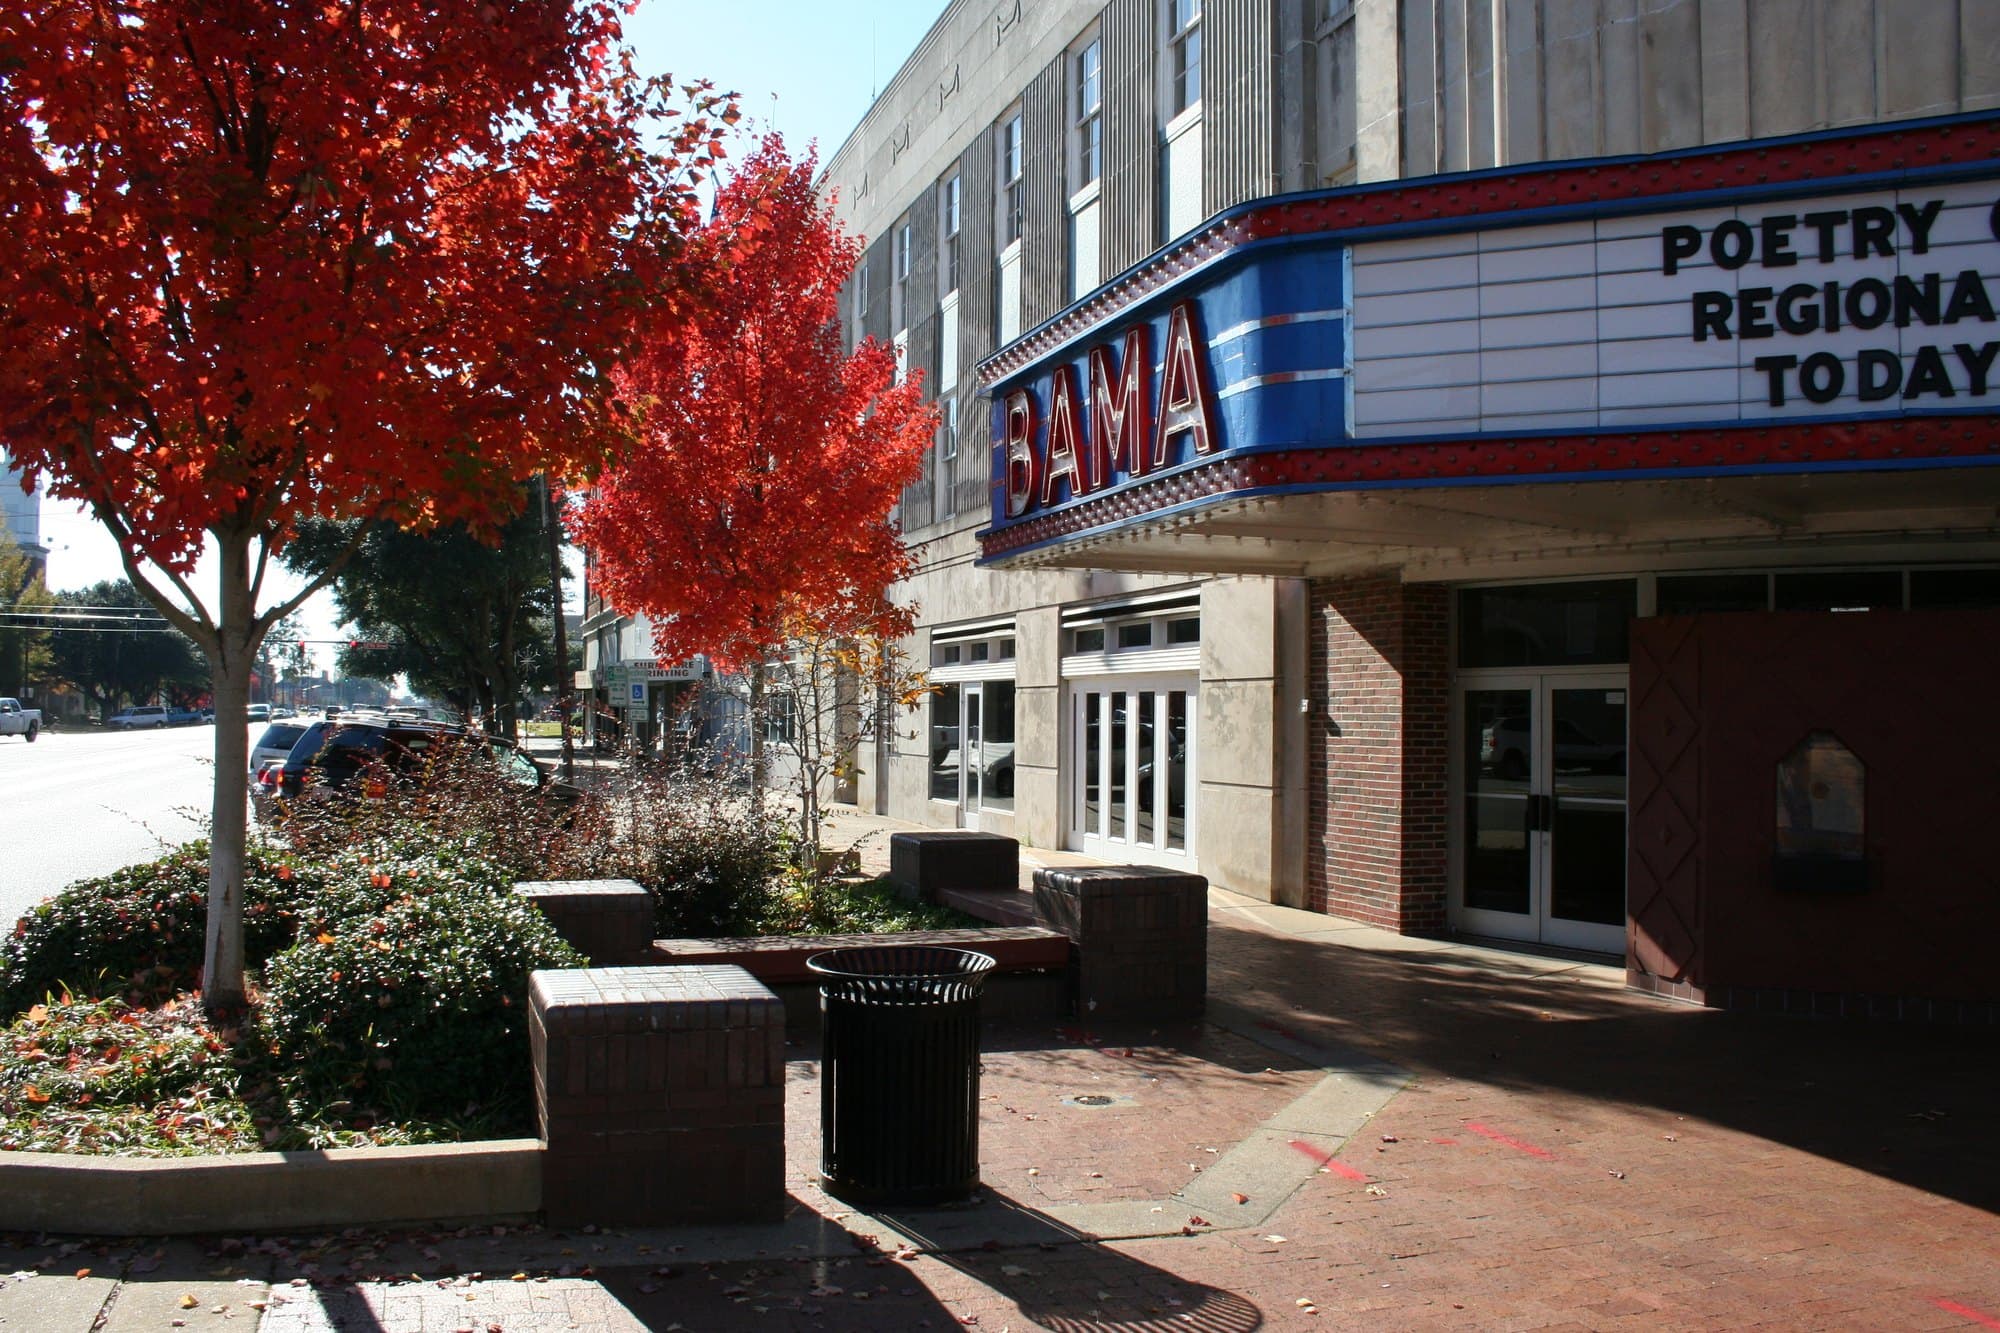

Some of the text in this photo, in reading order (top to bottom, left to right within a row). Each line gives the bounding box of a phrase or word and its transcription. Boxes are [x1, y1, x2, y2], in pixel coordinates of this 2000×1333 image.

[1663, 200, 1945, 276] POETRY
[1004, 298, 1220, 518] BAMA
[1755, 341, 2000, 407] TODAY
[647, 669, 689, 677] RINTING
